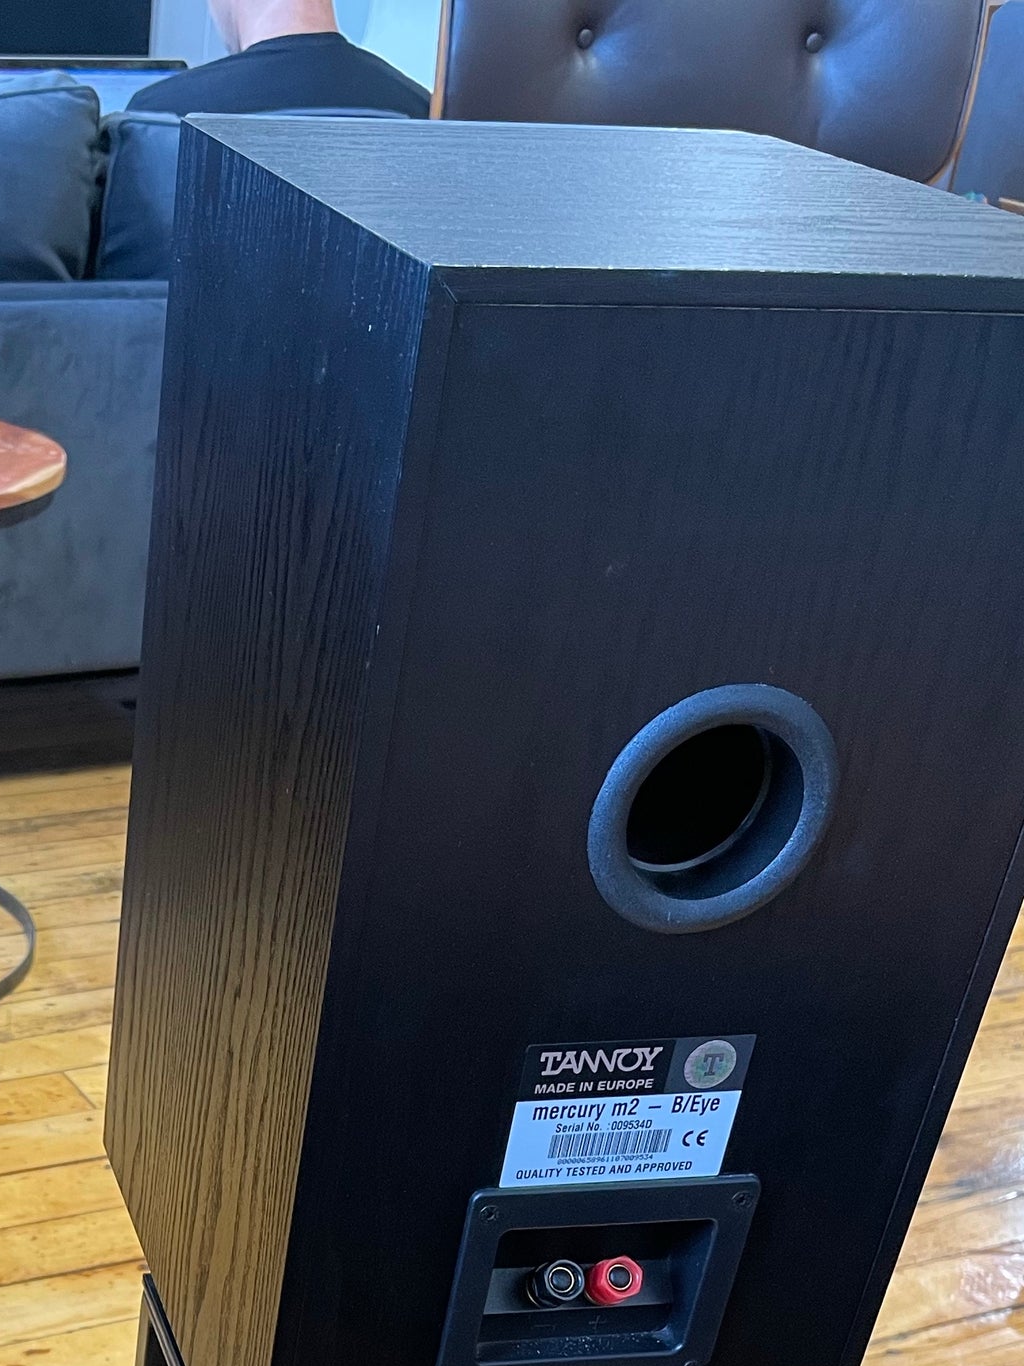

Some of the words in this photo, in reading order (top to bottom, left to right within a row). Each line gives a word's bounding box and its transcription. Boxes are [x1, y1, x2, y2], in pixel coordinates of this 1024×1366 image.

[540, 1046, 663, 1076] TANNOY
[704, 1053, 724, 1077] T
[534, 1082, 576, 1095] MADE
[579, 1081, 594, 1092] IN
[597, 1078, 654, 1091] EUROPE
[533, 1103, 606, 1122] mercury
[611, 1098, 640, 1116] m2
[671, 1094, 720, 1116] B/Eye
[555, 1122, 584, 1133] Serial
[682, 1129, 709, 1147] CE
[516, 1168, 562, 1180] QUALITY
[566, 1166, 606, 1177] TESTED
[609, 1164, 632, 1174] AND
[634, 1161, 692, 1173] APPROVED
